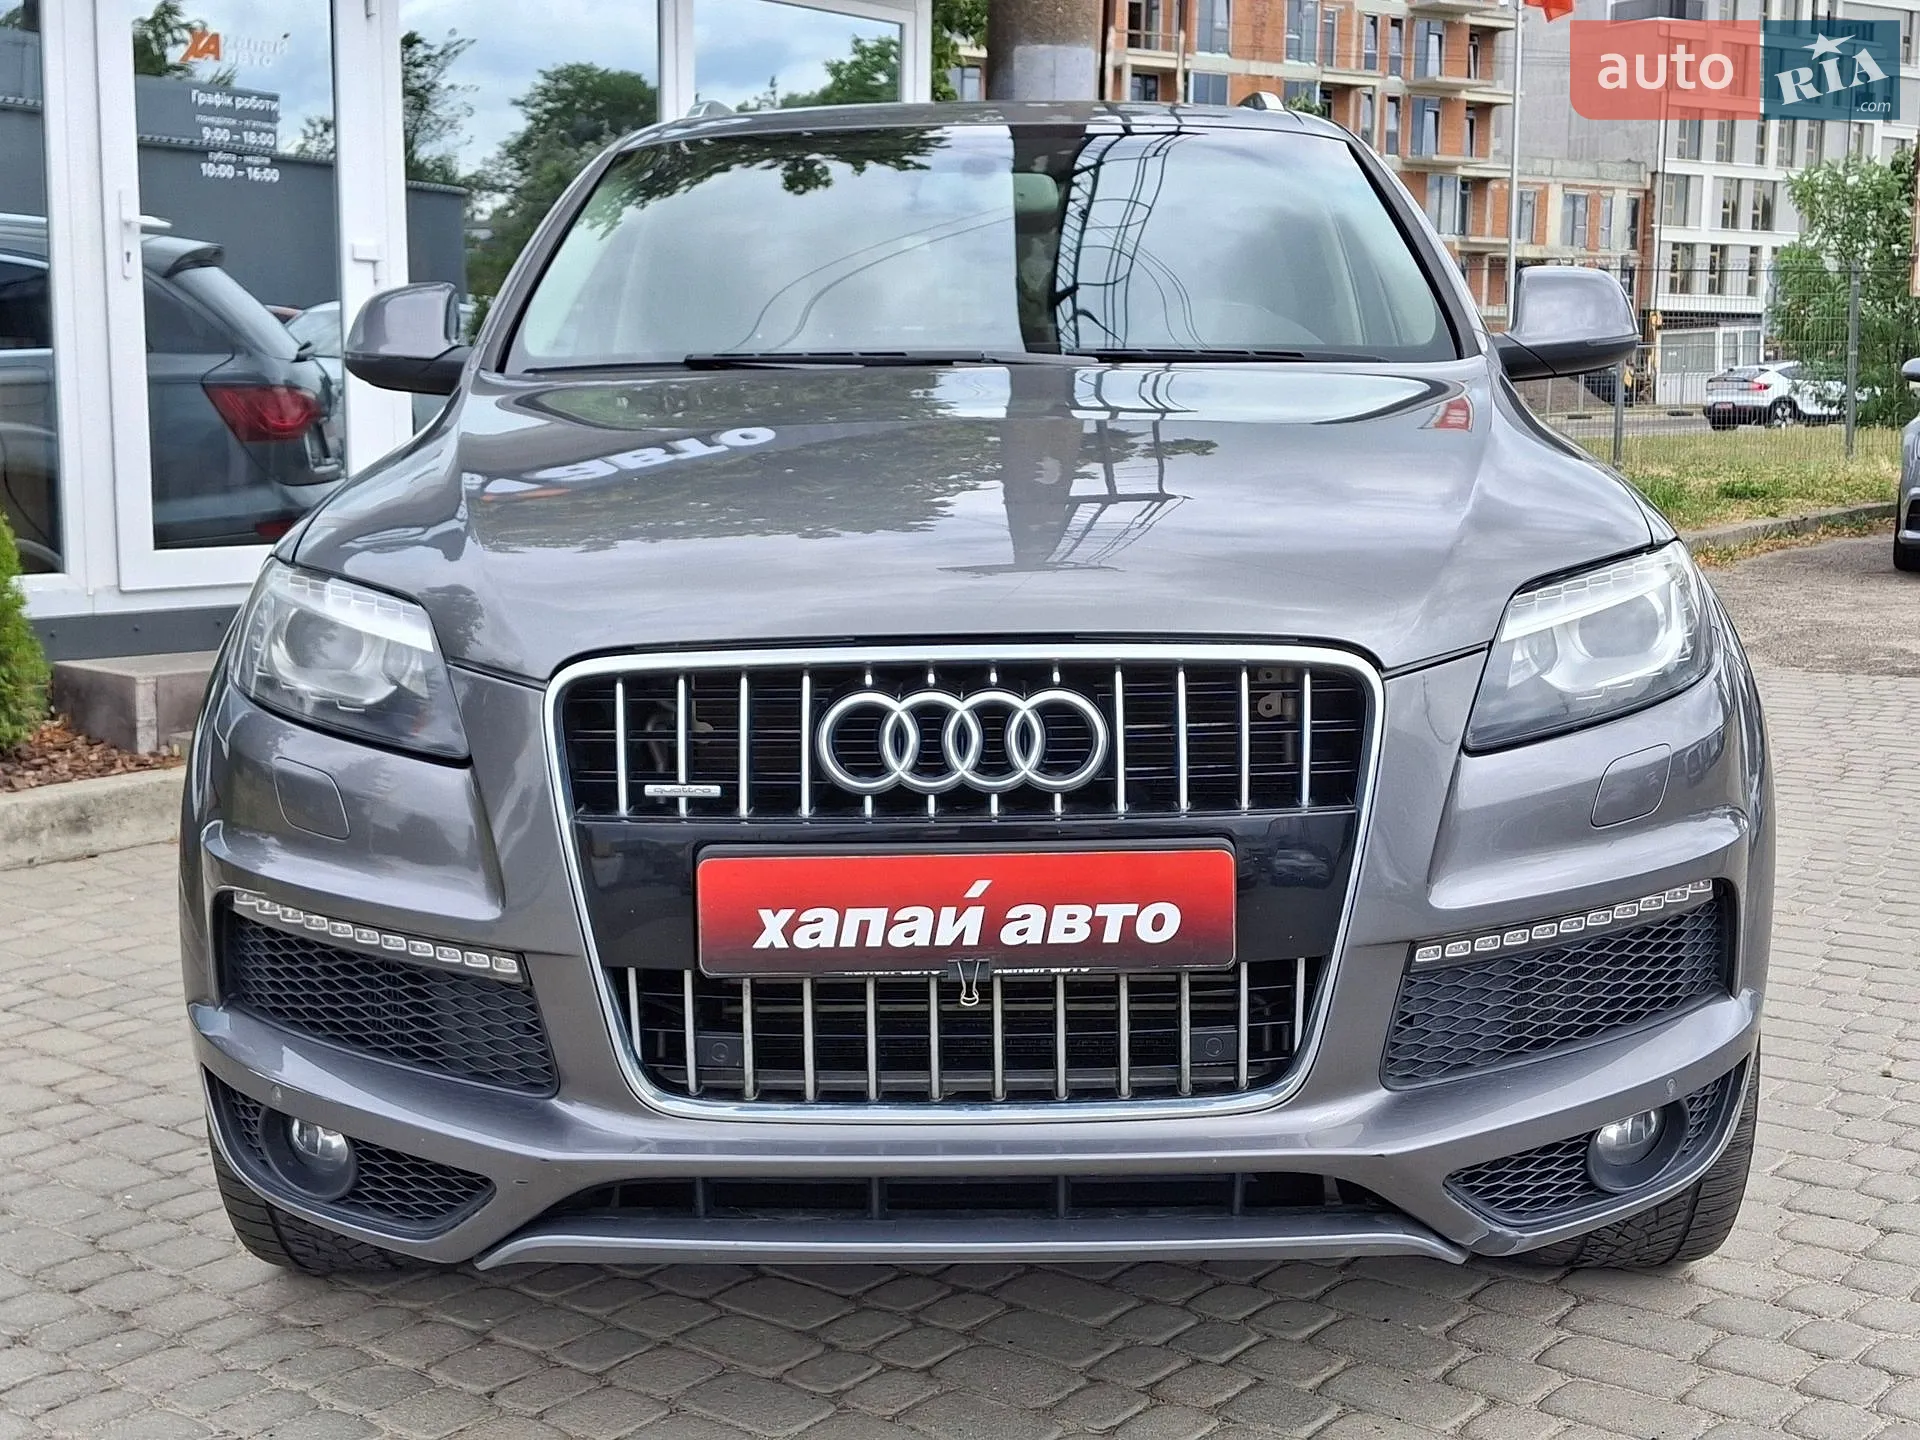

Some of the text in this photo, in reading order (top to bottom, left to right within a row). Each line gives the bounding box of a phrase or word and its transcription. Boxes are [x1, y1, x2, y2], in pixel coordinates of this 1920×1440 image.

[191, 89, 279, 112] Графік роботи
[202, 127, 231, 143] 9:00
[242, 131, 275, 147] 18:00
[201, 162, 235, 179] 10:00
[999, 901, 1182, 945] авто
